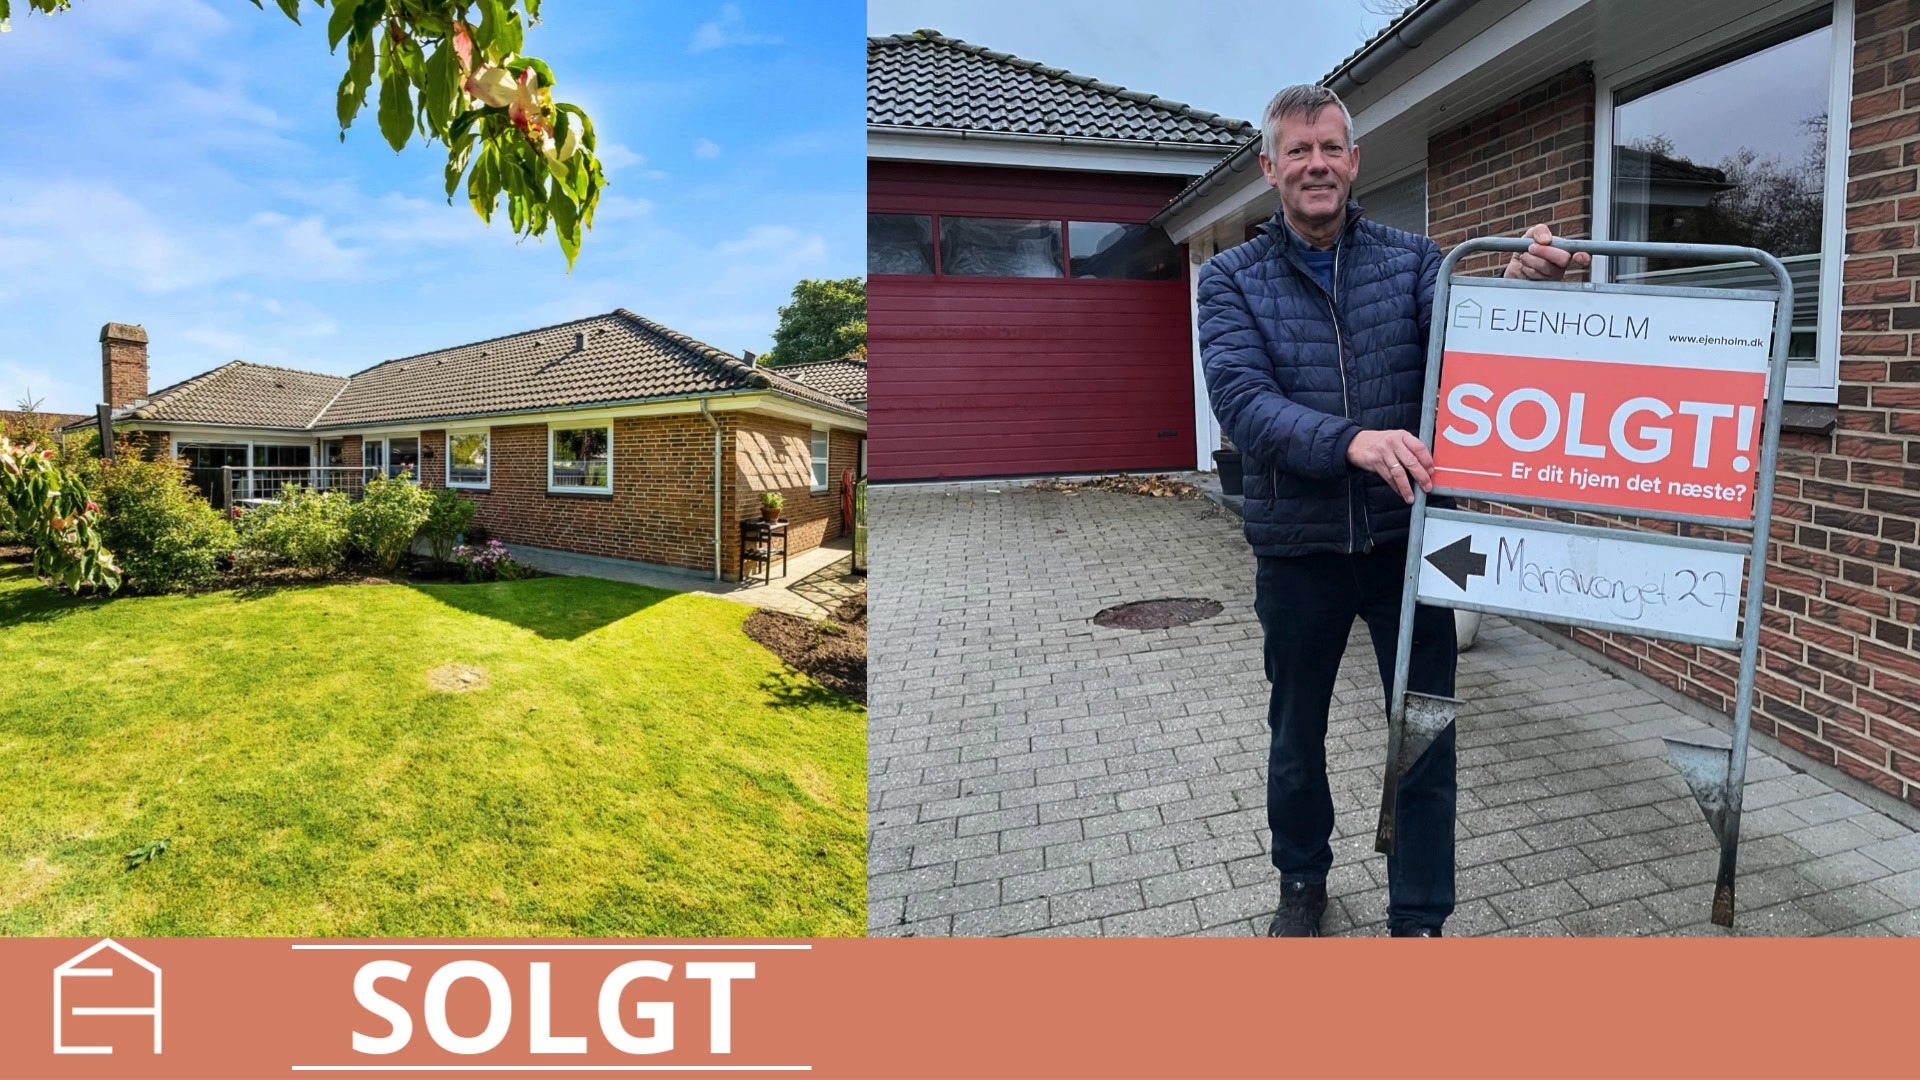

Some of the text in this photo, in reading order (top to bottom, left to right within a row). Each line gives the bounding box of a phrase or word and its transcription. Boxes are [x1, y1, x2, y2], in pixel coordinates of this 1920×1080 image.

[1490, 308, 1649, 340] EJENHOLM
[1668, 334, 1764, 348] www.ejenholm.dk
[1442, 383, 1756, 473] SOLGT!
[1511, 462, 1747, 502] Er dit hjem det næste?
[1674, 568, 1734, 612] 27
